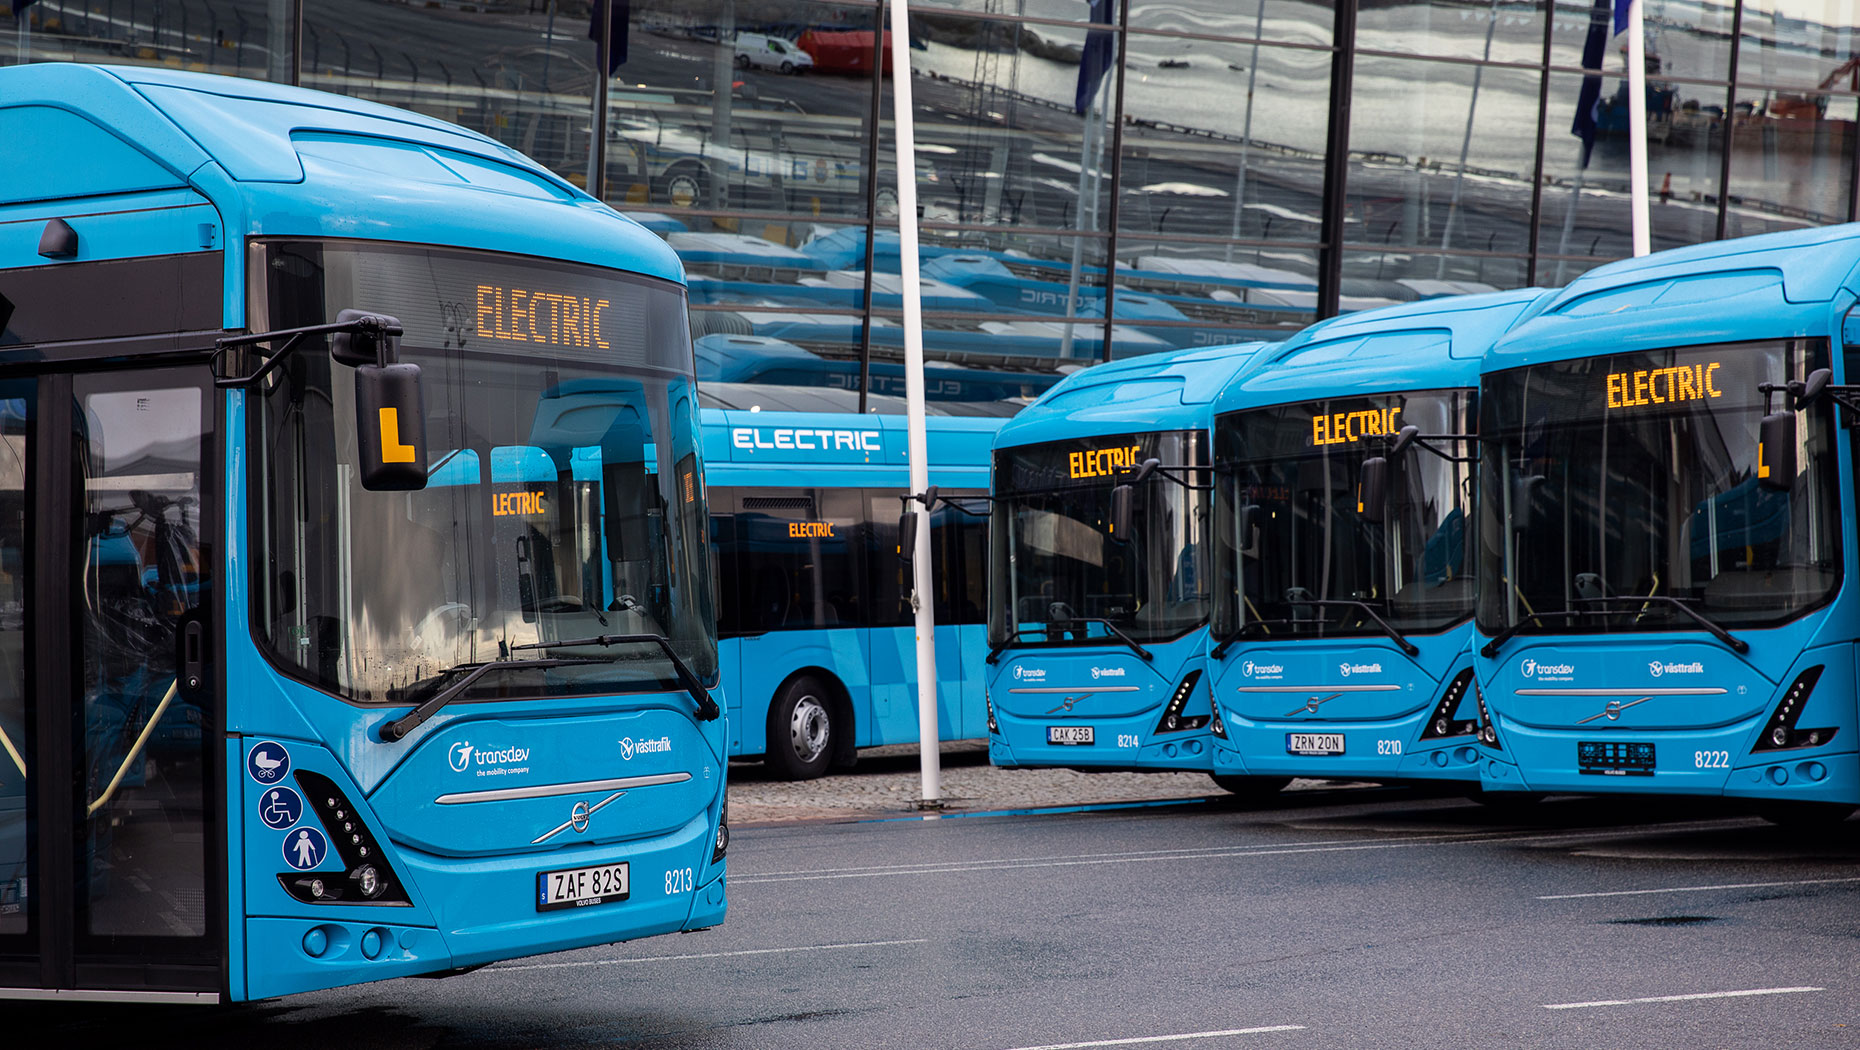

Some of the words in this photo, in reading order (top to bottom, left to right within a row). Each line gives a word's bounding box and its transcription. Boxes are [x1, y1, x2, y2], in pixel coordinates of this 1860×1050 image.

[477, 285, 610, 349] ELECTRIC
[1607, 362, 1722, 408] ELECTRIC
[1312, 406, 1401, 446] ELECTRIC
[732, 428, 881, 451] ELECTRIC
[1069, 445, 1141, 479] ELECTRIC
[492, 491, 545, 516] LECTRIC
[788, 522, 835, 538] ELECTRIC
[1536, 663, 1575, 674] transdev
[1663, 662, 1704, 674] västtrafik
[1053, 728, 1071, 741] CAK
[1072, 728, 1090, 741] 25B
[1117, 734, 1139, 748] 8214
[1295, 735, 1315, 750] ZRN
[1318, 736, 1339, 750] 20N
[634, 736, 672, 754] västtrafik
[1377, 739, 1402, 755] 8210
[474, 745, 530, 765] transdev
[1694, 750, 1730, 769] 8222
[476, 769, 486, 777] the
[486, 767, 507, 776] mobility
[507, 766, 530, 775] company
[555, 871, 586, 901] ZAF
[592, 867, 622, 895] 82S
[664, 867, 693, 895] 8213
[576, 898, 589, 907] VOLVO
[589, 897, 602, 906] BUSES
